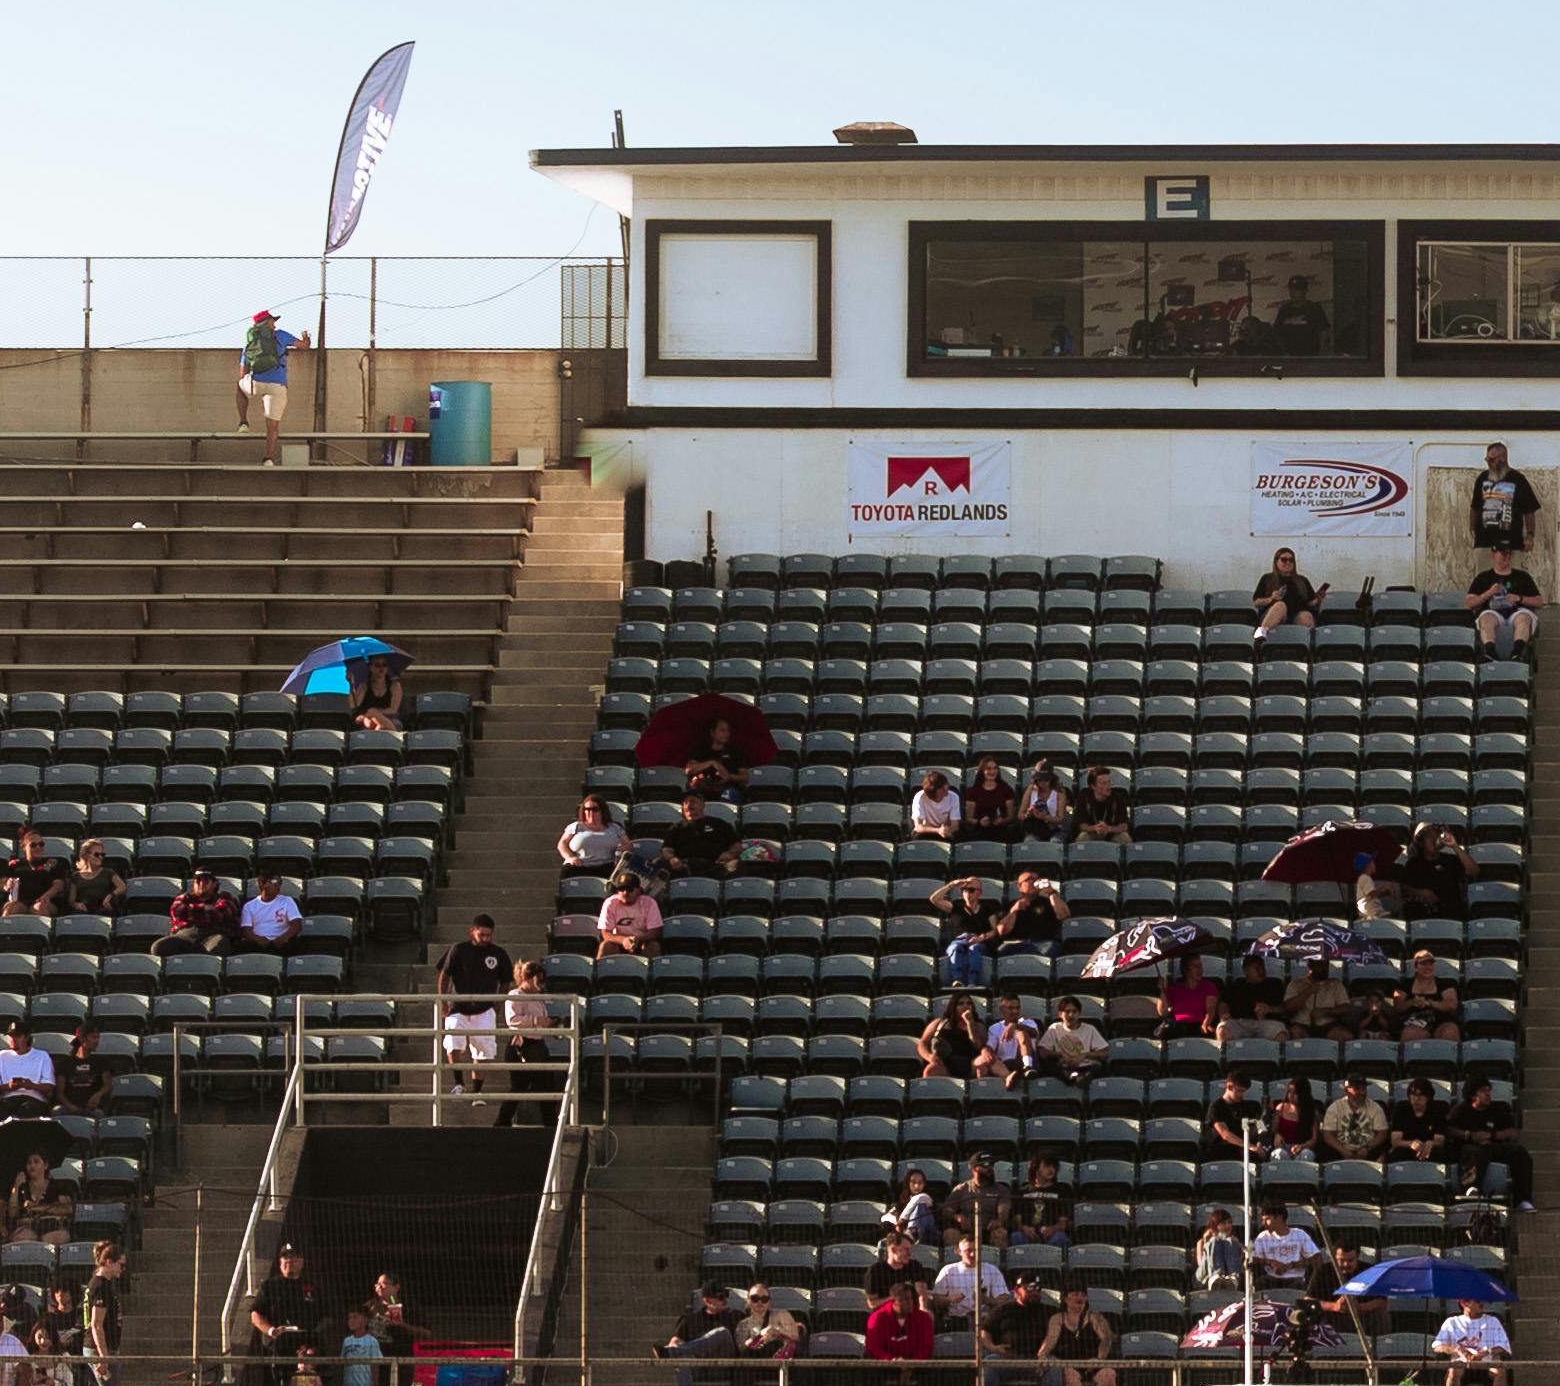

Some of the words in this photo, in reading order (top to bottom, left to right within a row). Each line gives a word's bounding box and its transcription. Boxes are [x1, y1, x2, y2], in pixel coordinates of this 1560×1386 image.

[1156, 179, 1198, 218] E
[924, 481, 938, 495] R
[1255, 475, 1378, 490] BURGESON'S
[1261, 491, 1295, 499] HEATING
[1319, 491, 1367, 499] ELECTRICAL
[1277, 499, 1302, 507] SOLAR
[1306, 499, 1344, 507] PLUMBING
[851, 505, 915, 521] TOYOTA
[917, 504, 1008, 521] REDLANDS
